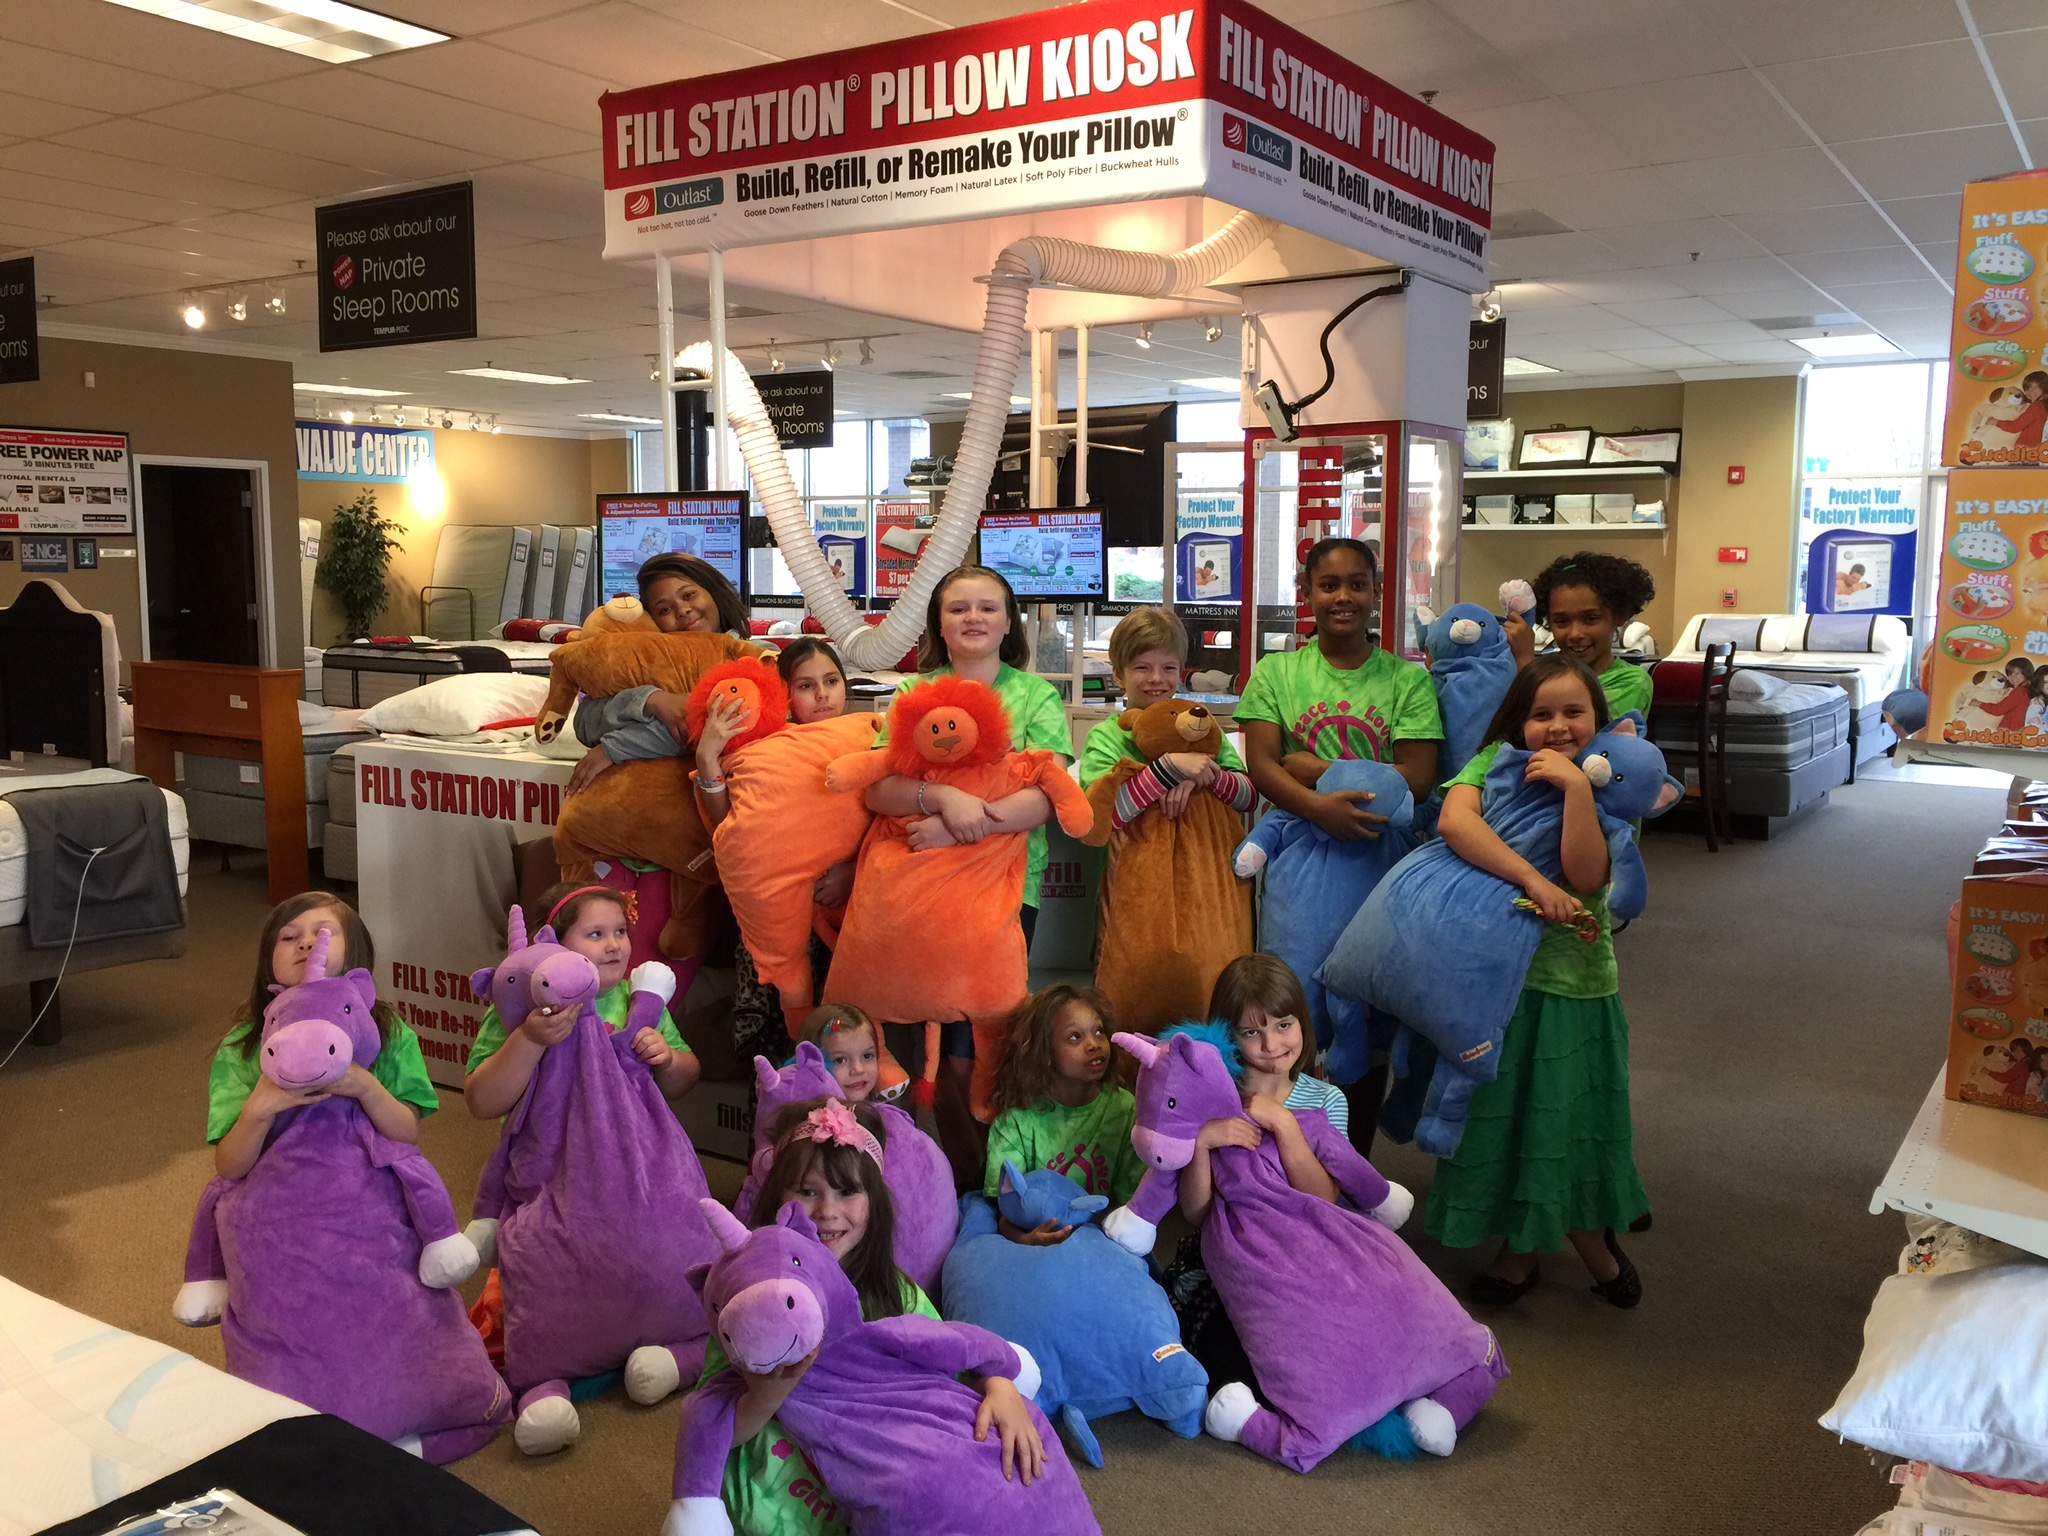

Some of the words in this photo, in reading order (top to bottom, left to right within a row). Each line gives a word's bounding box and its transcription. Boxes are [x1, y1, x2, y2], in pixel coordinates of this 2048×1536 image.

[616, 109, 680, 170] FILL
[871, 45, 1031, 130] PILLOW
[1042, 9, 1196, 101] KIOSK
[1219, 14, 1266, 101] FILL
[1372, 105, 1440, 188] PILLOW
[1442, 145, 1491, 212] KIOSK
[1252, 133, 1285, 163] Outlast
[736, 166, 800, 202] Build,
[805, 156, 871, 194] Refill,
[877, 156, 903, 184] or
[908, 138, 1012, 181] Remake
[1018, 129, 1080, 165] Your
[744, 207, 767, 218] Goose
[768, 203, 790, 215] Down
[792, 200, 825, 212] Feathers
[830, 196, 859, 208] Natural
[860, 192, 889, 204] Cotton
[895, 188, 928, 200] Memory
[930, 184, 954, 195] Foam
[960, 178, 992, 191] Natural
[994, 175, 1018, 187] Latex
[1025, 171, 1044, 182] Soft
[1046, 169, 1066, 180] Poly
[1068, 165, 1093, 176] Fiber
[1101, 159, 1153, 173] Buckwheat
[1155, 156, 1180, 168] Hulls
[1300, 146, 1335, 196] Build,
[1338, 165, 1371, 212] Refill,
[1373, 188, 1386, 215] or
[1387, 190, 1430, 234] Remake
[1432, 209, 1454, 243] Your
[663, 185, 712, 209] Outlast
[637, 225, 649, 234] Not
[649, 224, 660, 232] too
[674, 220, 685, 228] not
[685, 218, 696, 226] too
[1972, 212, 2008, 229] It's
[2011, 208, 2048, 226] EAS
[327, 229, 367, 248] Please
[370, 223, 391, 242] ask
[393, 216, 432, 238] about
[435, 215, 457, 232] our
[362, 252, 426, 283] Private
[339, 268, 353, 286] NAP
[333, 295, 386, 323] Sleep
[391, 287, 459, 315] Rooms
[0, 340, 28, 359] oms
[1468, 339, 1490, 350] our
[770, 387, 783, 397] ask
[785, 386, 809, 396] about
[810, 386, 823, 395] our
[782, 421, 825, 435] Rooms
[0, 445, 27, 459] REE
[30, 446, 90, 461] POWER
[93, 449, 123, 463] NAP
[295, 428, 357, 474] VALUE
[361, 432, 431, 478] CENTER
[22, 460, 33, 468] 30
[35, 461, 72, 469] MINUTES
[74, 462, 95, 470] FREE
[1829, 487, 1872, 505] Protect
[1873, 487, 1901, 504] Your
[667, 501, 682, 515] FILL
[713, 500, 740, 514] PILLOW
[822, 505, 842, 518] Protect
[843, 505, 858, 518] Your
[1188, 498, 1217, 513] Protect
[1217, 498, 1236, 512] Your
[1955, 500, 1990, 515] It's
[1038, 514, 1050, 525] FILL
[1077, 512, 1101, 524] PILLOW
[1177, 515, 1207, 529] Factory
[1813, 507, 1857, 525] Factory
[1858, 507, 1915, 525] Warranty
[815, 519, 836, 533] Factory
[838, 519, 865, 533] Warranty
[22, 543, 34, 558] BE
[1101, 604, 1130, 612] SIMMONS
[1185, 607, 1222, 616] MATTRESS
[361, 764, 406, 808] FILL
[523, 781, 561, 826] PIL
[1055, 886, 1085, 897] PILLOW
[1969, 906, 1997, 920] It's
[2000, 910, 2047, 926] EASY!
[393, 962, 430, 995] FILL
[409, 1003, 438, 1029] Year
